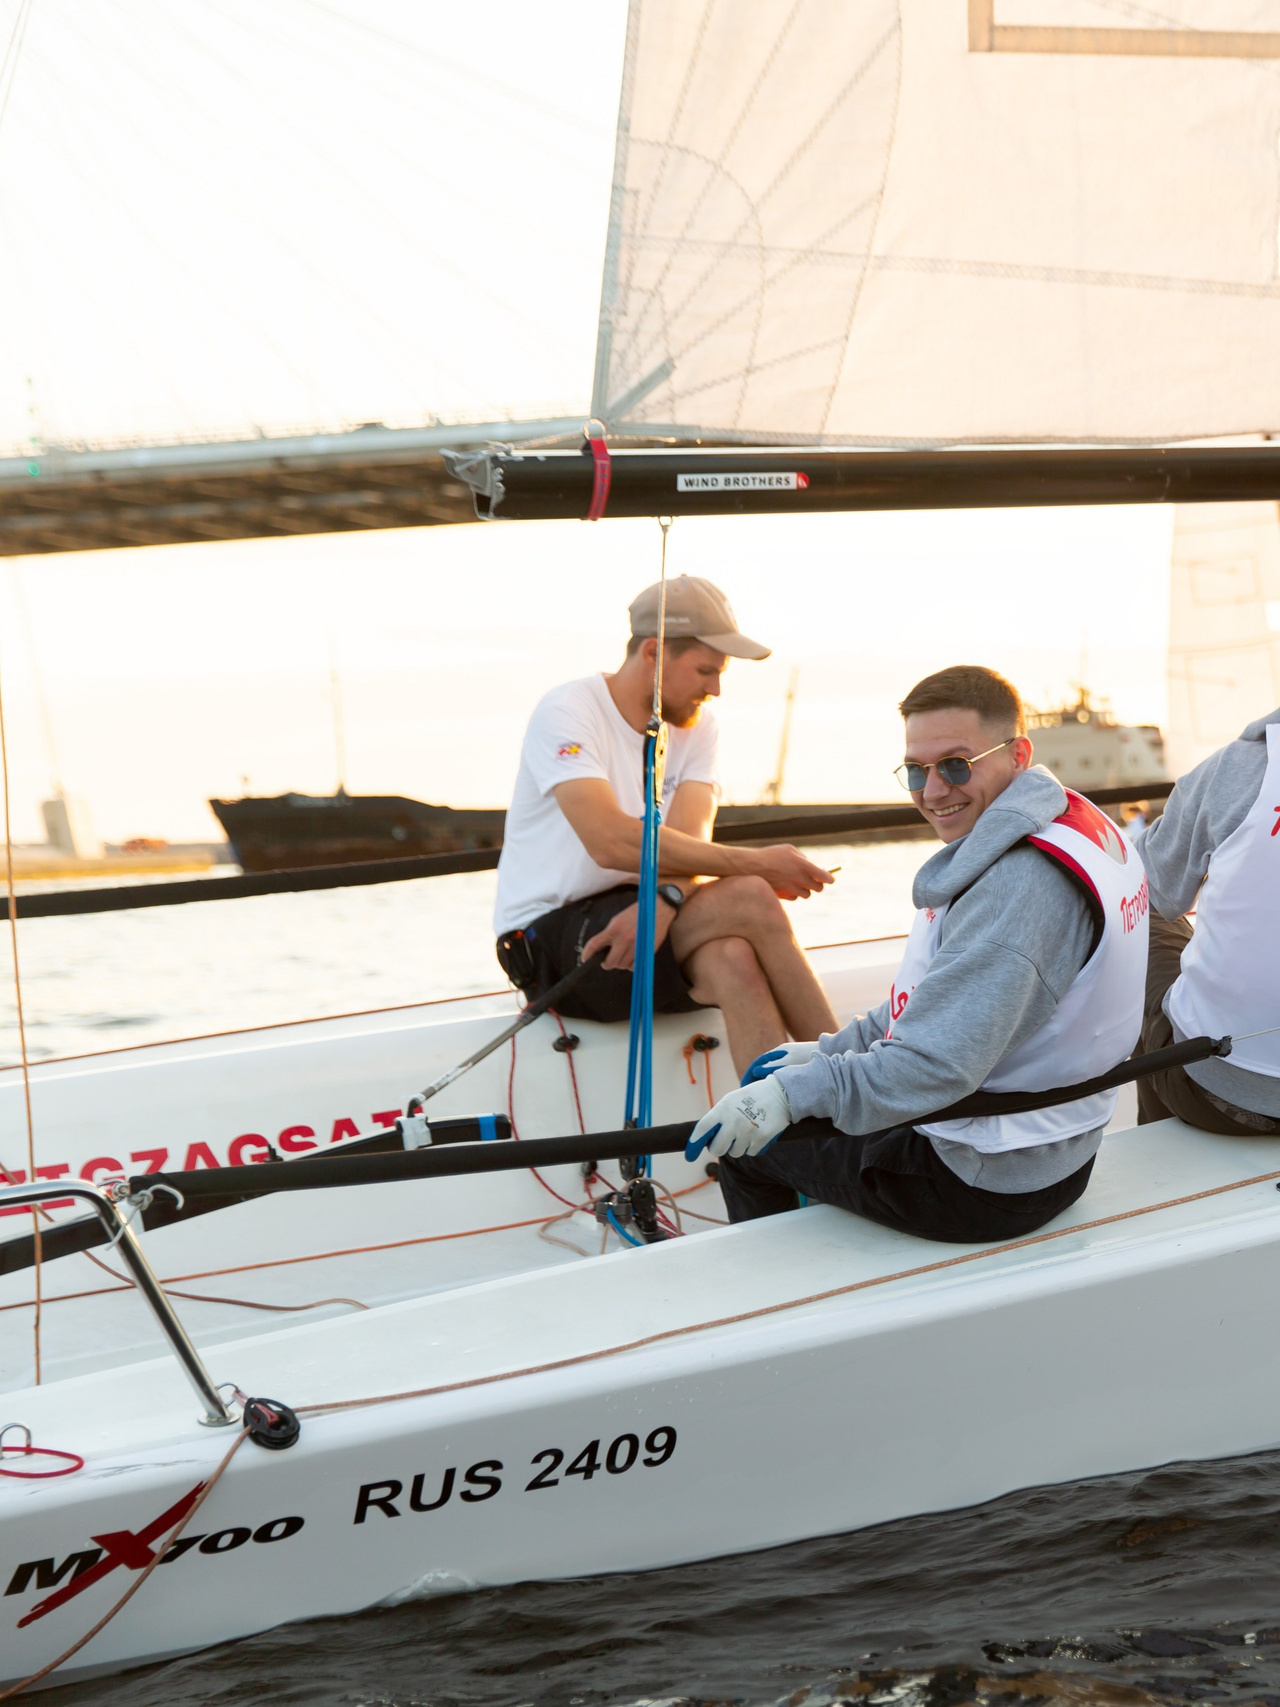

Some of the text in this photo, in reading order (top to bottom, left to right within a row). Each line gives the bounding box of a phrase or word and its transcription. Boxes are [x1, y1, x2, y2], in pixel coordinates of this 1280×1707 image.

[683, 475, 791, 488] WIND BROTHERS
[353, 1425, 677, 1525] RUS 2409
